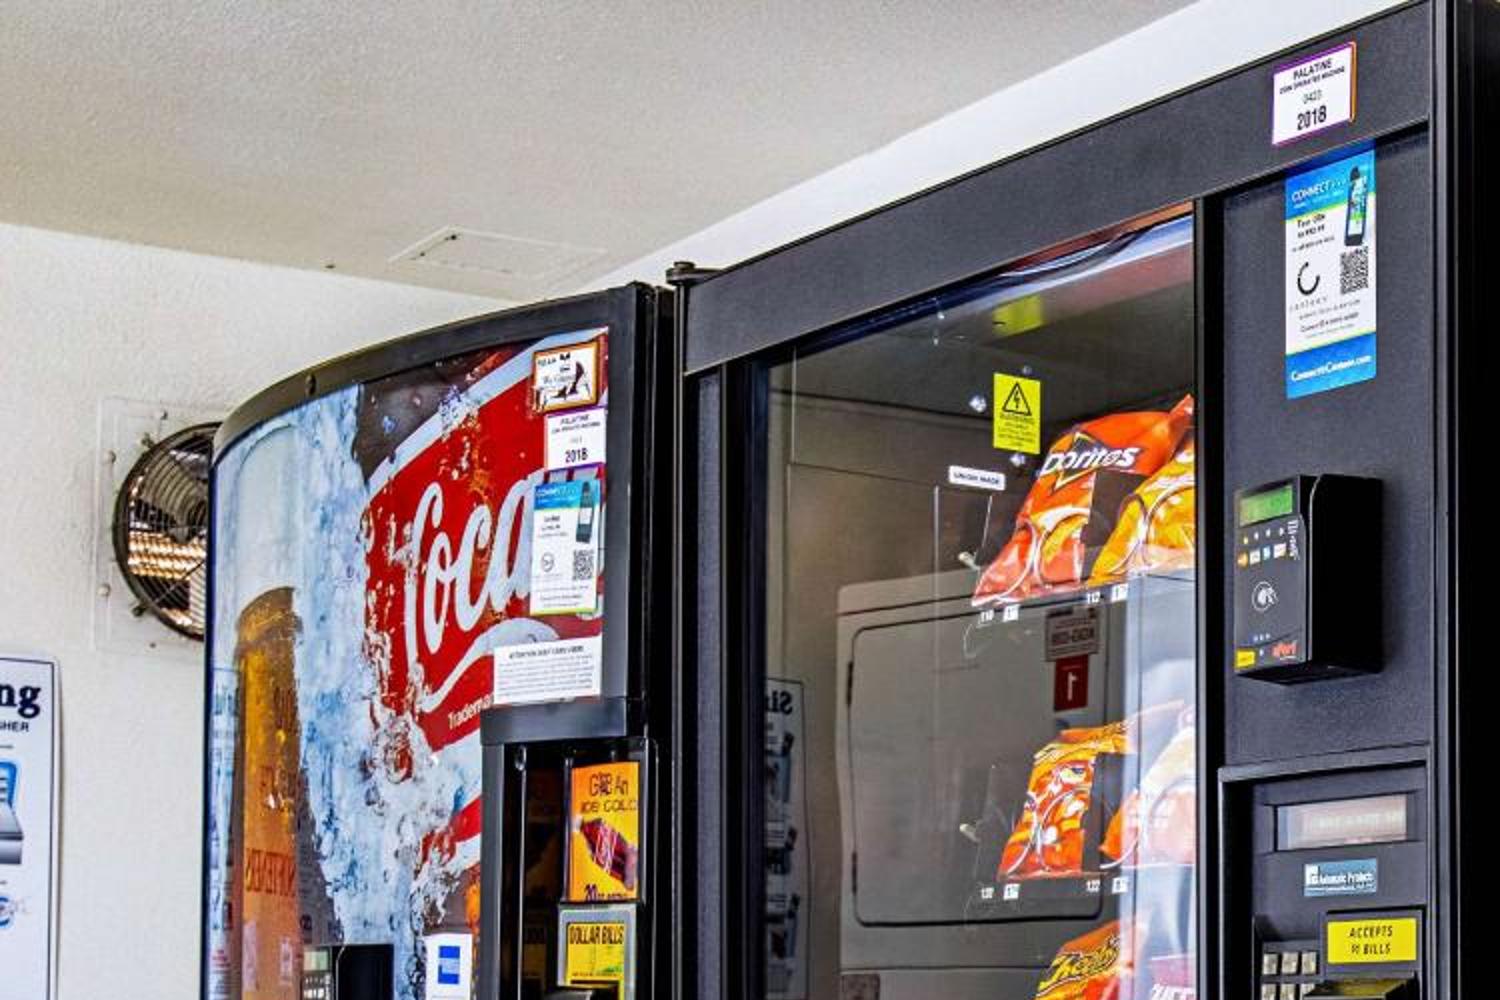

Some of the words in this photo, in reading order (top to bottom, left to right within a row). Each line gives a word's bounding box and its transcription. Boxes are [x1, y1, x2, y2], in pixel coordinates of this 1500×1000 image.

[1297, 105, 1327, 131] 2018
[1038, 447, 1141, 476] Doritos
[980, 475, 999, 485] MADE
[570, 926, 600, 945] DOLLAR
[602, 925, 624, 944] BILLS
[1349, 925, 1393, 938] ACCEPTS
[1363, 944, 1391, 955] BILLS
